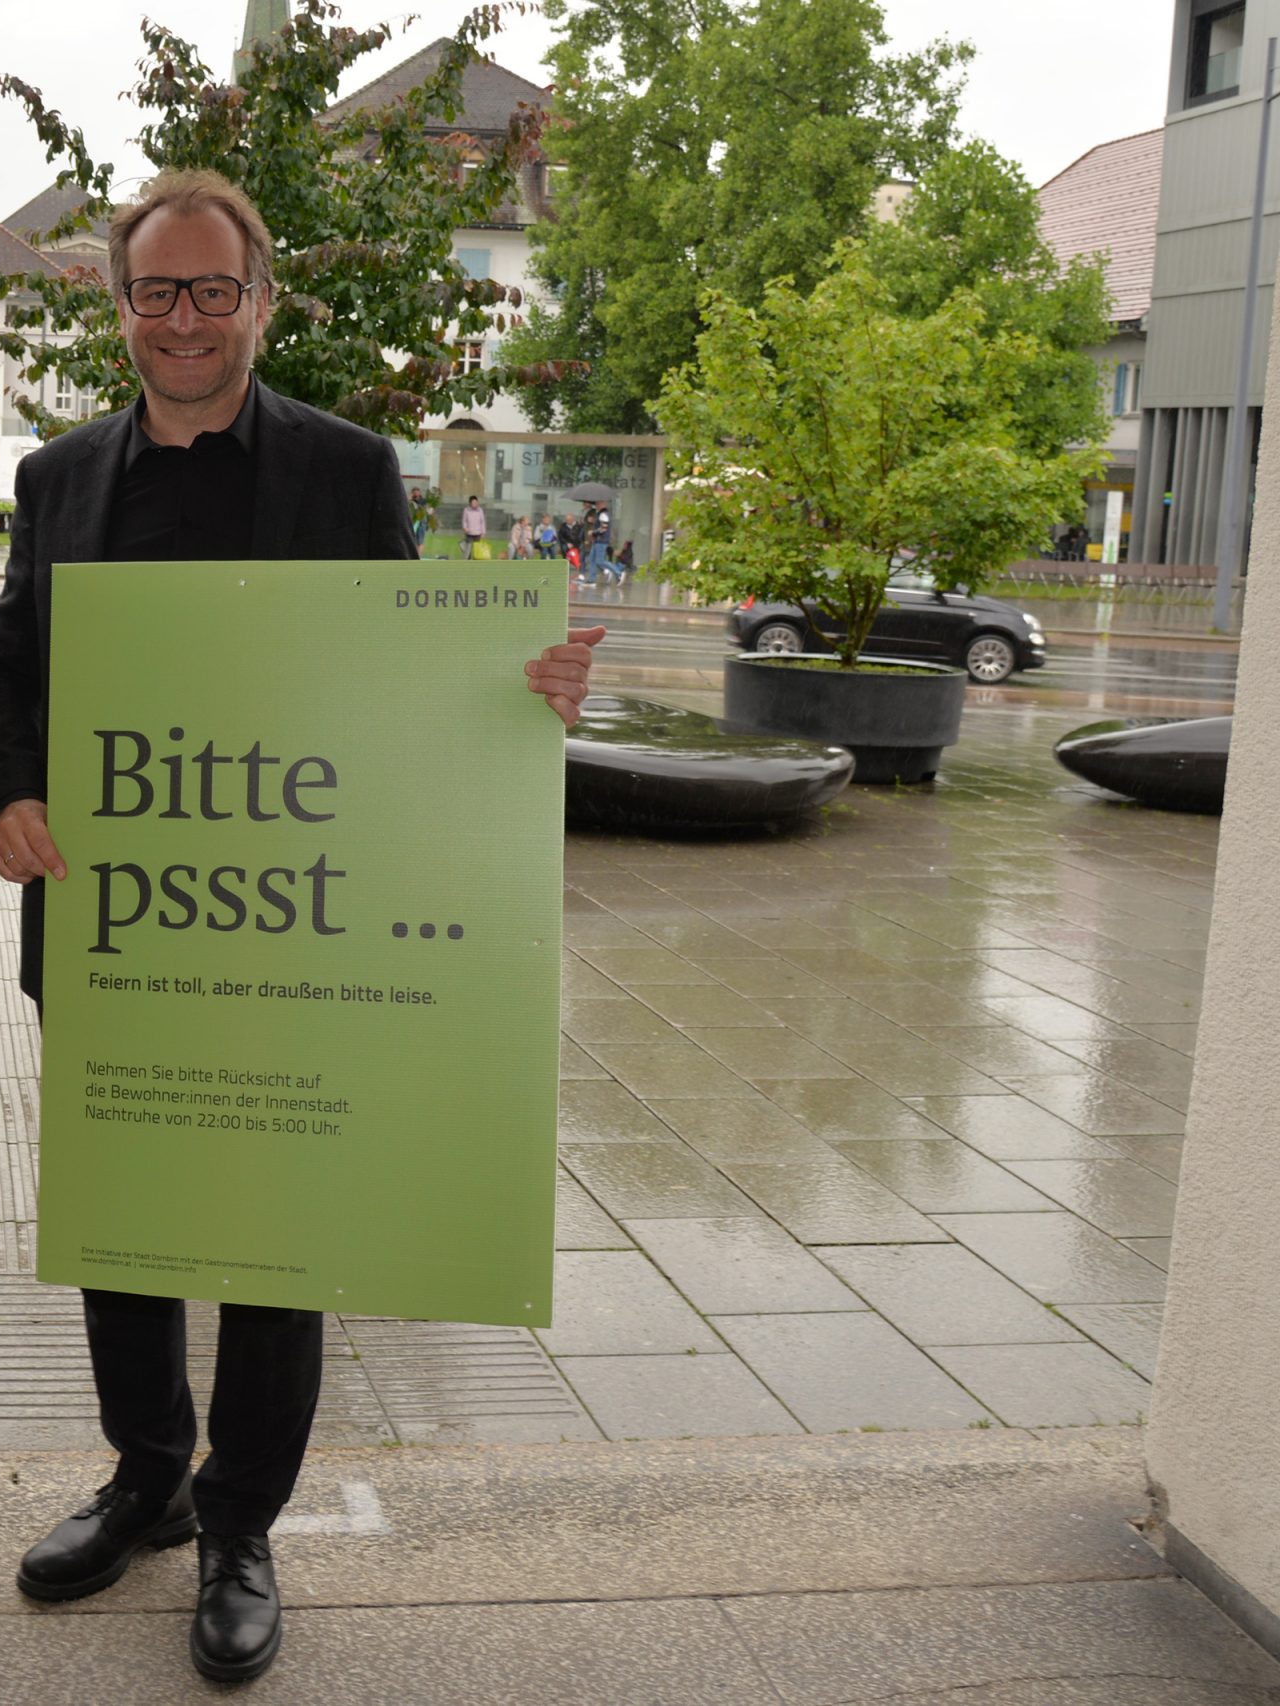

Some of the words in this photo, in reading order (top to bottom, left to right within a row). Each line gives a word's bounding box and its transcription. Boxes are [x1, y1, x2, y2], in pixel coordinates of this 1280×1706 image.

[396, 586, 538, 607] DORNBIRN
[92, 727, 337, 822] Bitte
[88, 854, 345, 954] pssst
[90, 973, 141, 990] Feiern
[148, 976, 168, 992] ist
[174, 978, 206, 996] toll,
[213, 979, 252, 996] aber
[258, 981, 333, 1000] draußen
[341, 984, 383, 1002] bitte
[390, 986, 436, 1004] leise.
[87, 1061, 146, 1078] Nehmen
[152, 1065, 173, 1080] Sie
[179, 1067, 213, 1082] bitte
[219, 1069, 291, 1087] Rücksicht
[296, 1074, 321, 1088] auf
[86, 1083, 105, 1097] die
[111, 1085, 230, 1106] Bewohner:innen
[236, 1093, 260, 1107] der
[266, 1095, 352, 1113] Innenstadt.
[86, 1104, 160, 1124] Nachtruhe
[165, 1114, 191, 1126] von
[197, 1113, 240, 1129] 22:00
[246, 1116, 267, 1131] bis
[272, 1118, 306, 1133] 5:00
[312, 1120, 341, 1135] Uhr.
